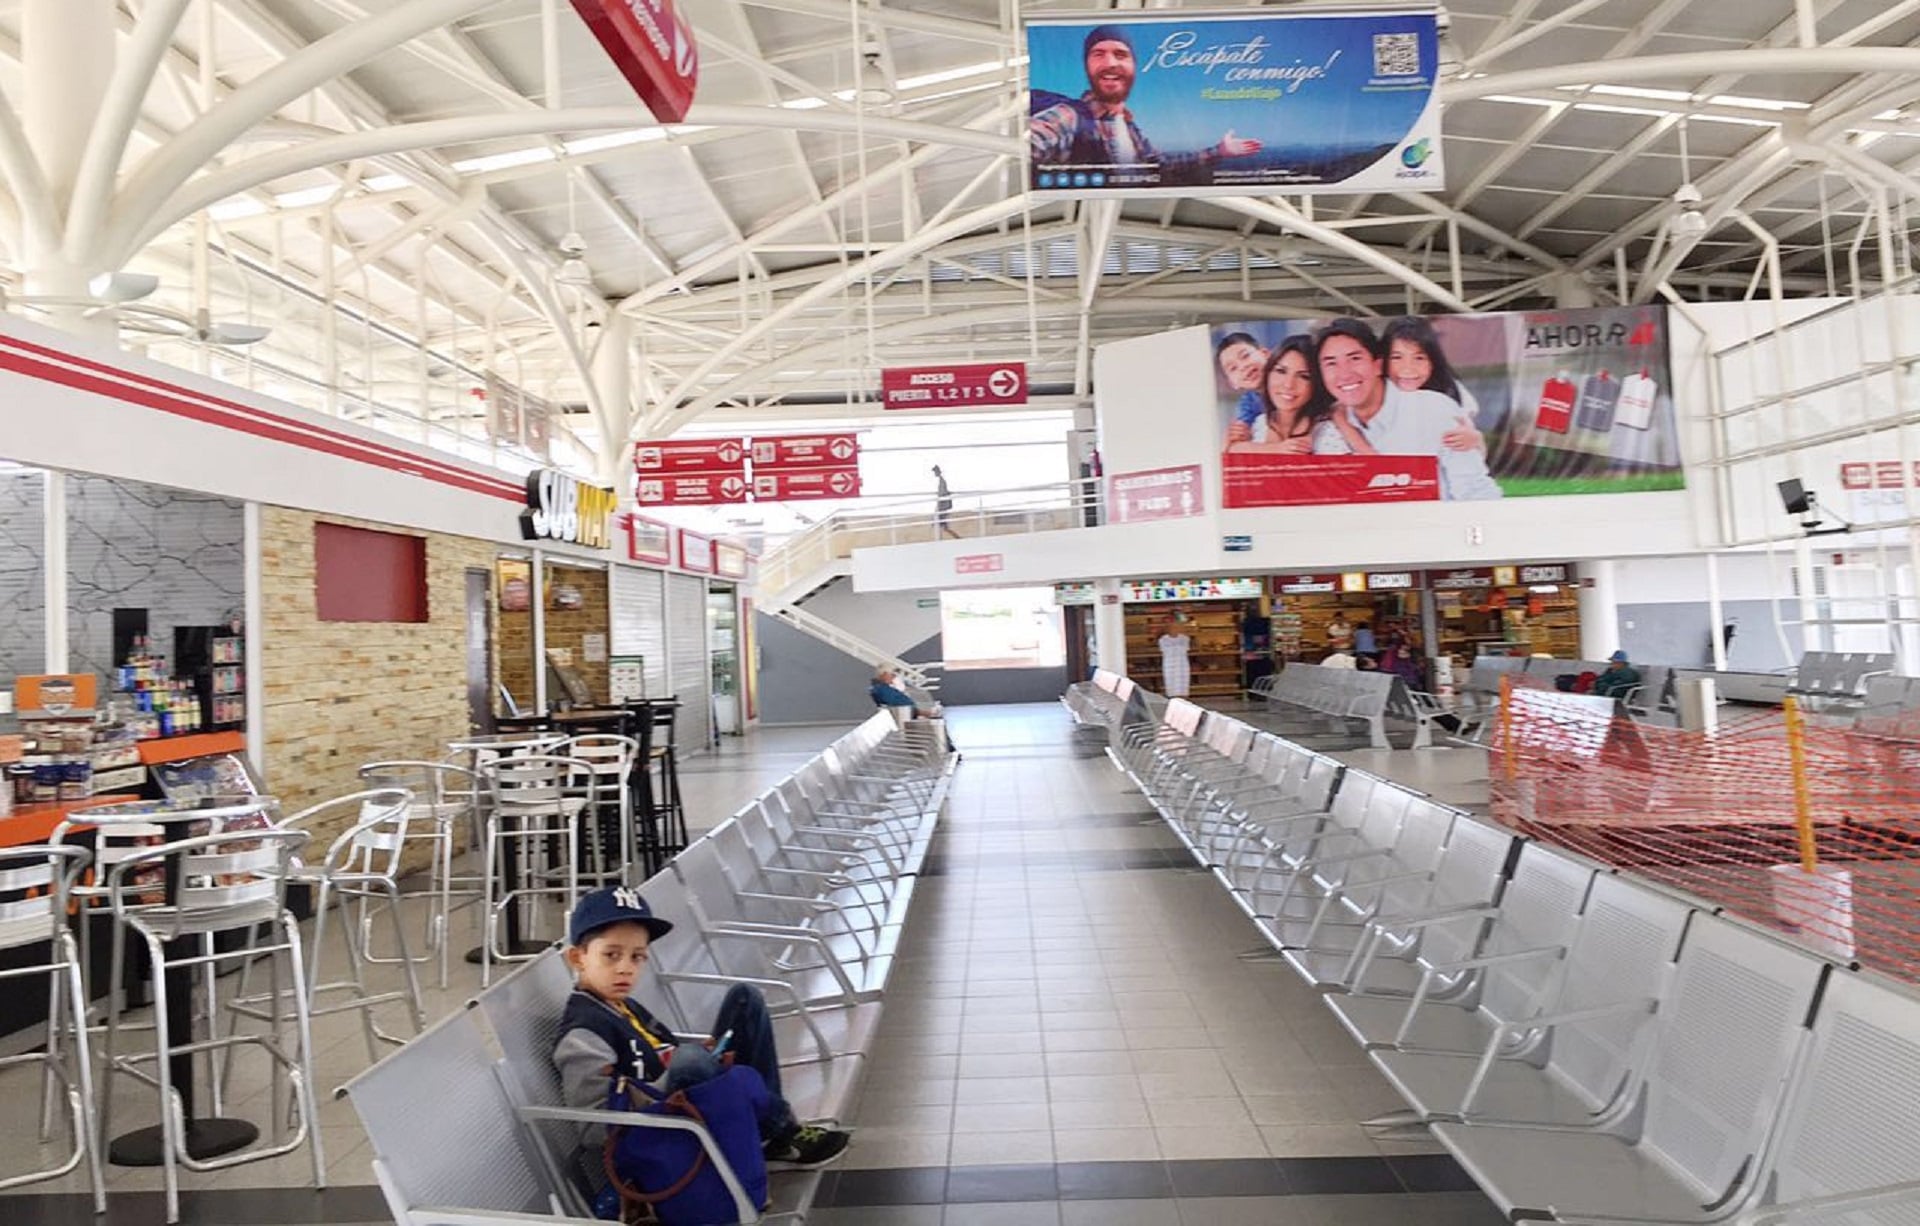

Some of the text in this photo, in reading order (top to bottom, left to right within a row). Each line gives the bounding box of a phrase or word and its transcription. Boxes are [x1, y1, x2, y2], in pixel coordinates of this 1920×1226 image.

[1225, 50, 1341, 93] conmigo!
[976, 386, 985, 398] 3
[1133, 586, 1222, 600] TIENDITA
[612, 886, 643, 910] NY
